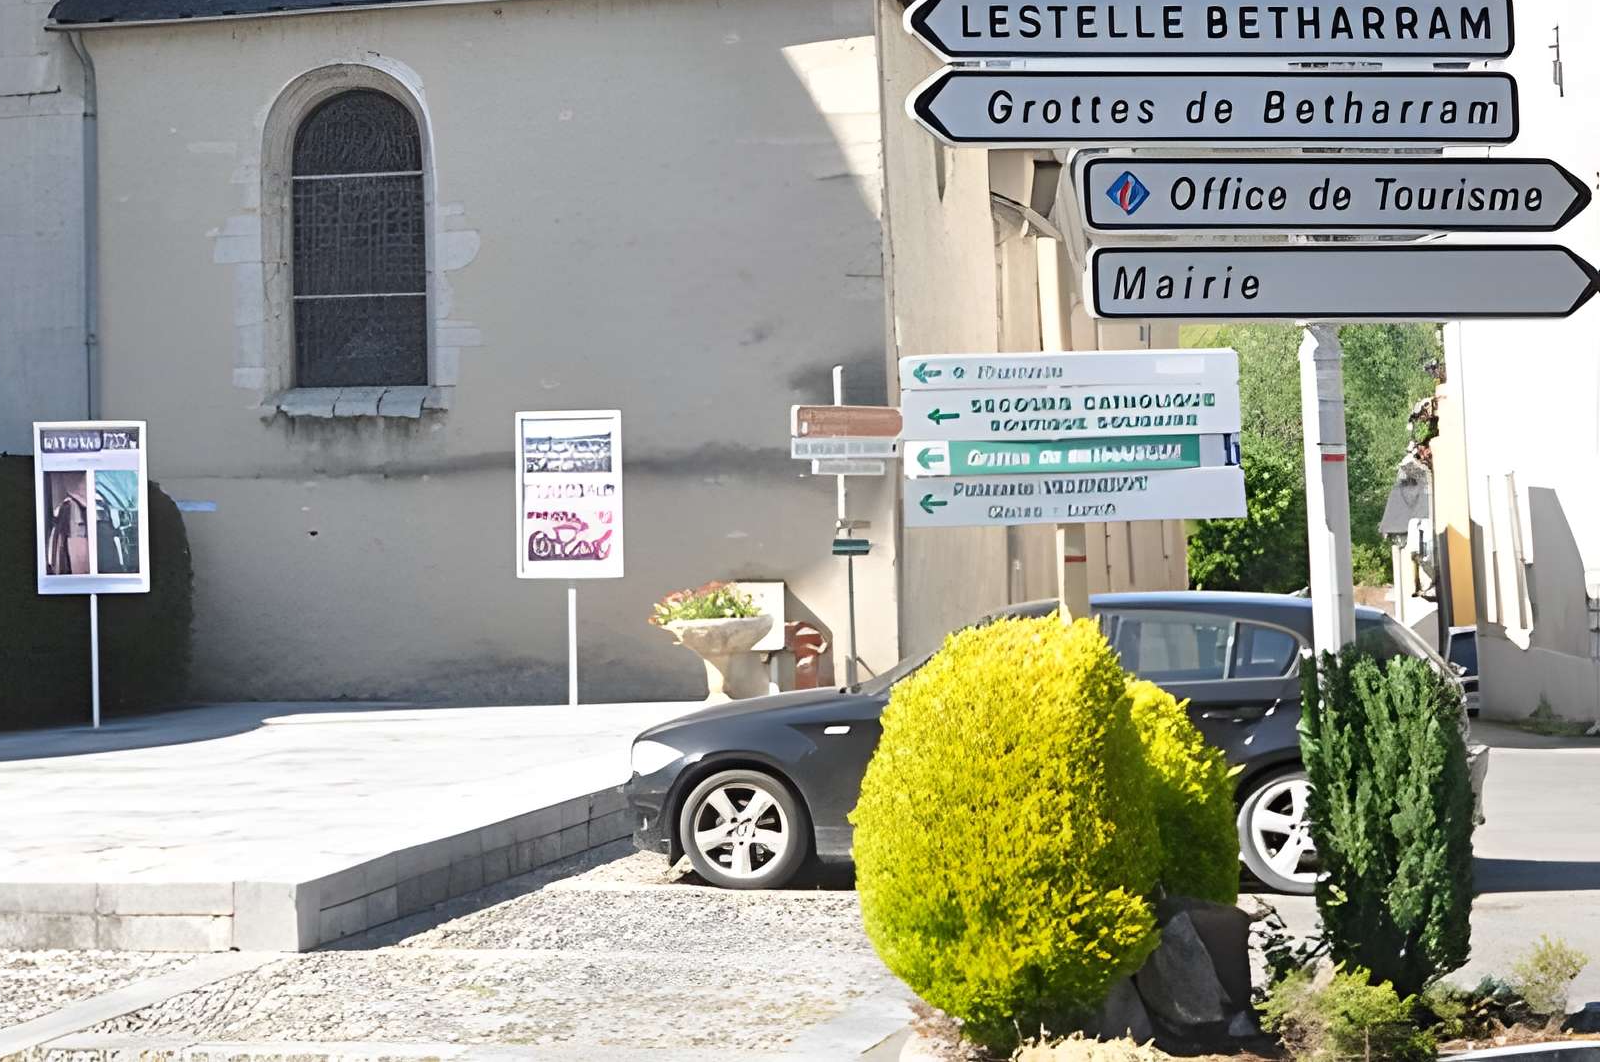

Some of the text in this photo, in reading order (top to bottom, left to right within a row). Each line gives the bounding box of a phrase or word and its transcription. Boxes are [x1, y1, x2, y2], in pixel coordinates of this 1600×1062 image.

[961, 4, 1492, 40] LESTELLE BETHARRAM
[987, 89, 1498, 125] Grottes de Betharram
[1170, 176, 1543, 212] Office de Tourisme
[1112, 265, 1260, 300] Mairie
